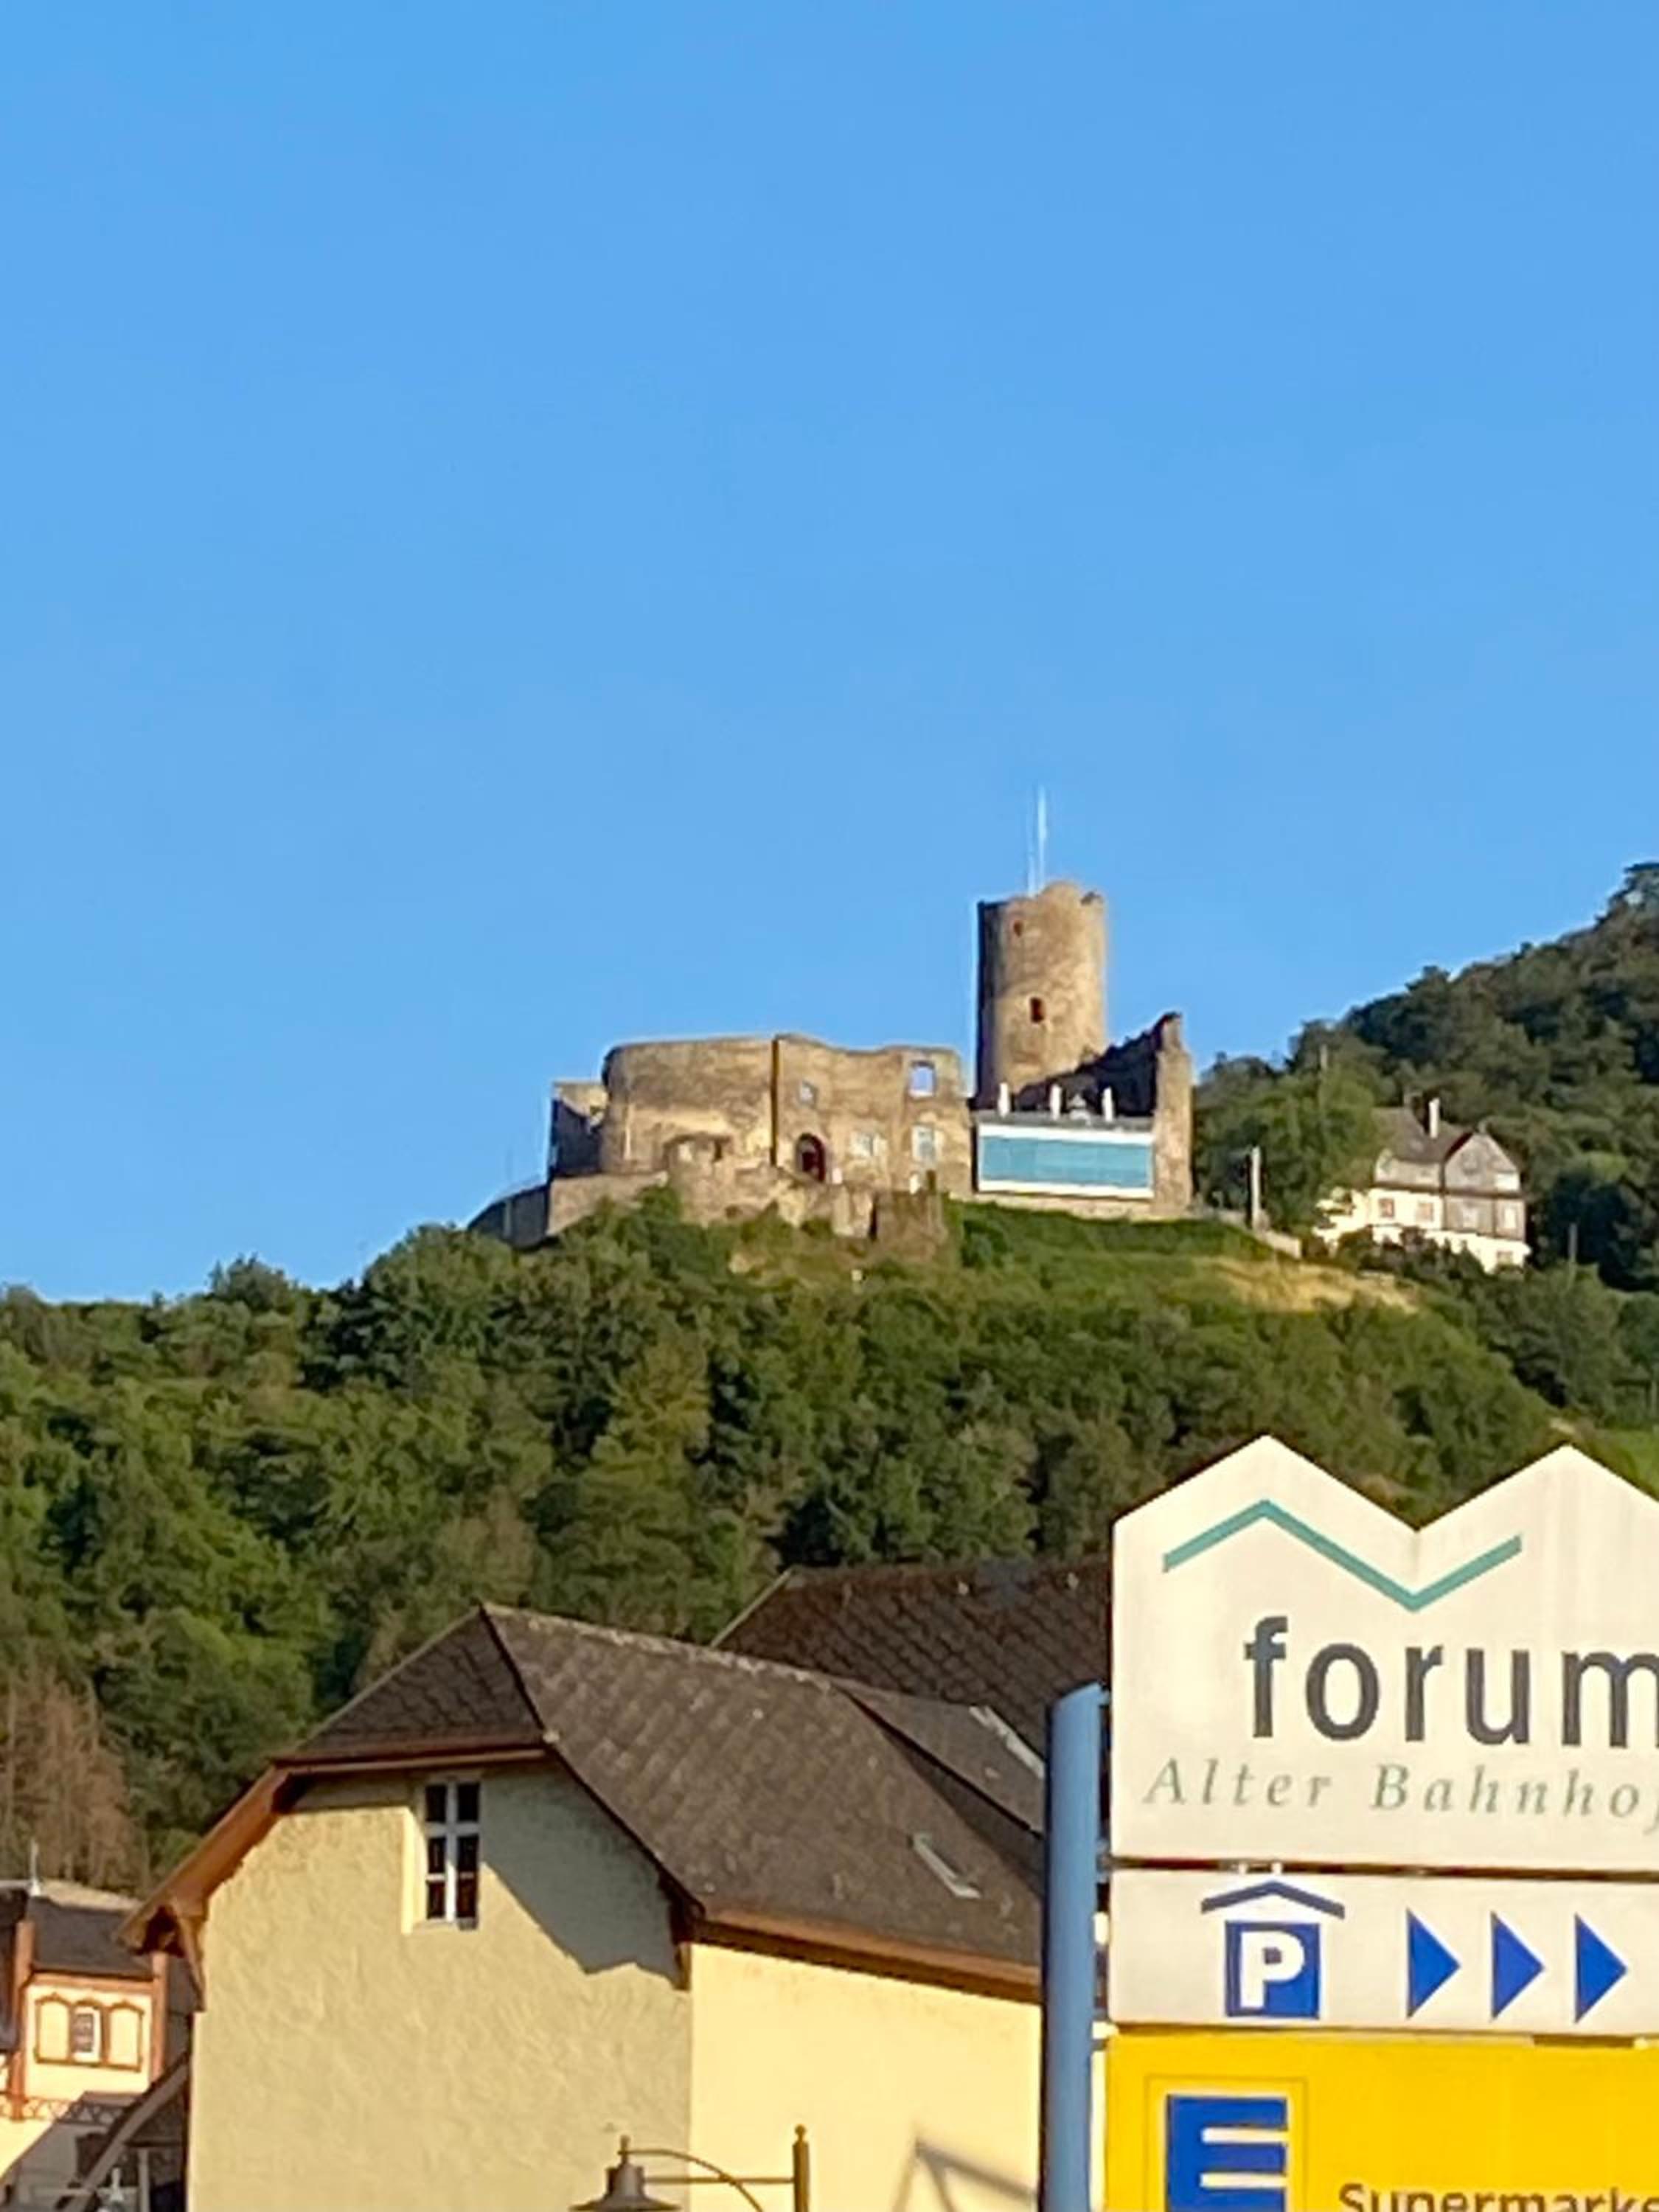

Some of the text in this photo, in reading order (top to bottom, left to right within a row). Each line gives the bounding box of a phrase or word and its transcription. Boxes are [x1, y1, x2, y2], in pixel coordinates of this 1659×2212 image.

[1244, 1615, 1659, 1749] forum
[1142, 1757, 1332, 1807] Alter
[1239, 1930, 1306, 2010] P
